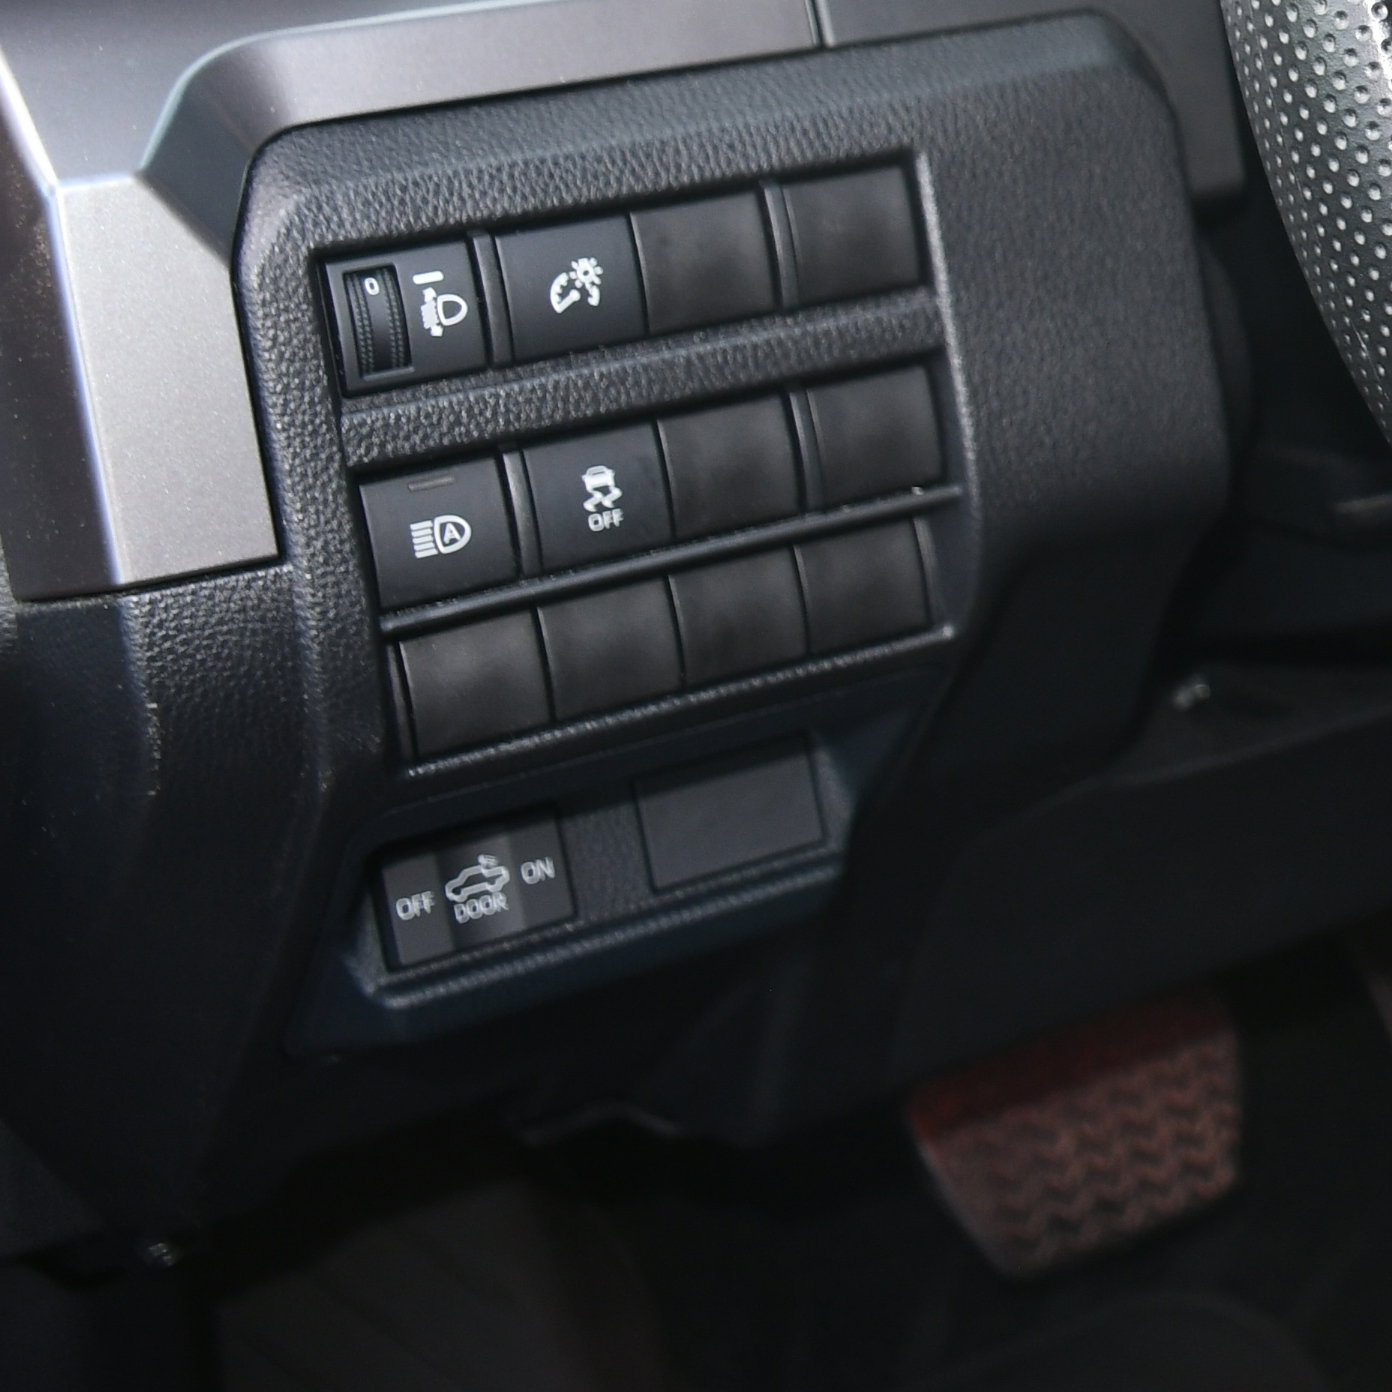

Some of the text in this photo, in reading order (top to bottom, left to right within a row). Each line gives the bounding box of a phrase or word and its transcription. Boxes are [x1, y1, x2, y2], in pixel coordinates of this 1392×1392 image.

[443, 522, 461, 544] A
[588, 508, 624, 532] OFF
[520, 857, 556, 885] ON
[396, 890, 435, 921] OFF
[454, 891, 509, 924] DOOR
